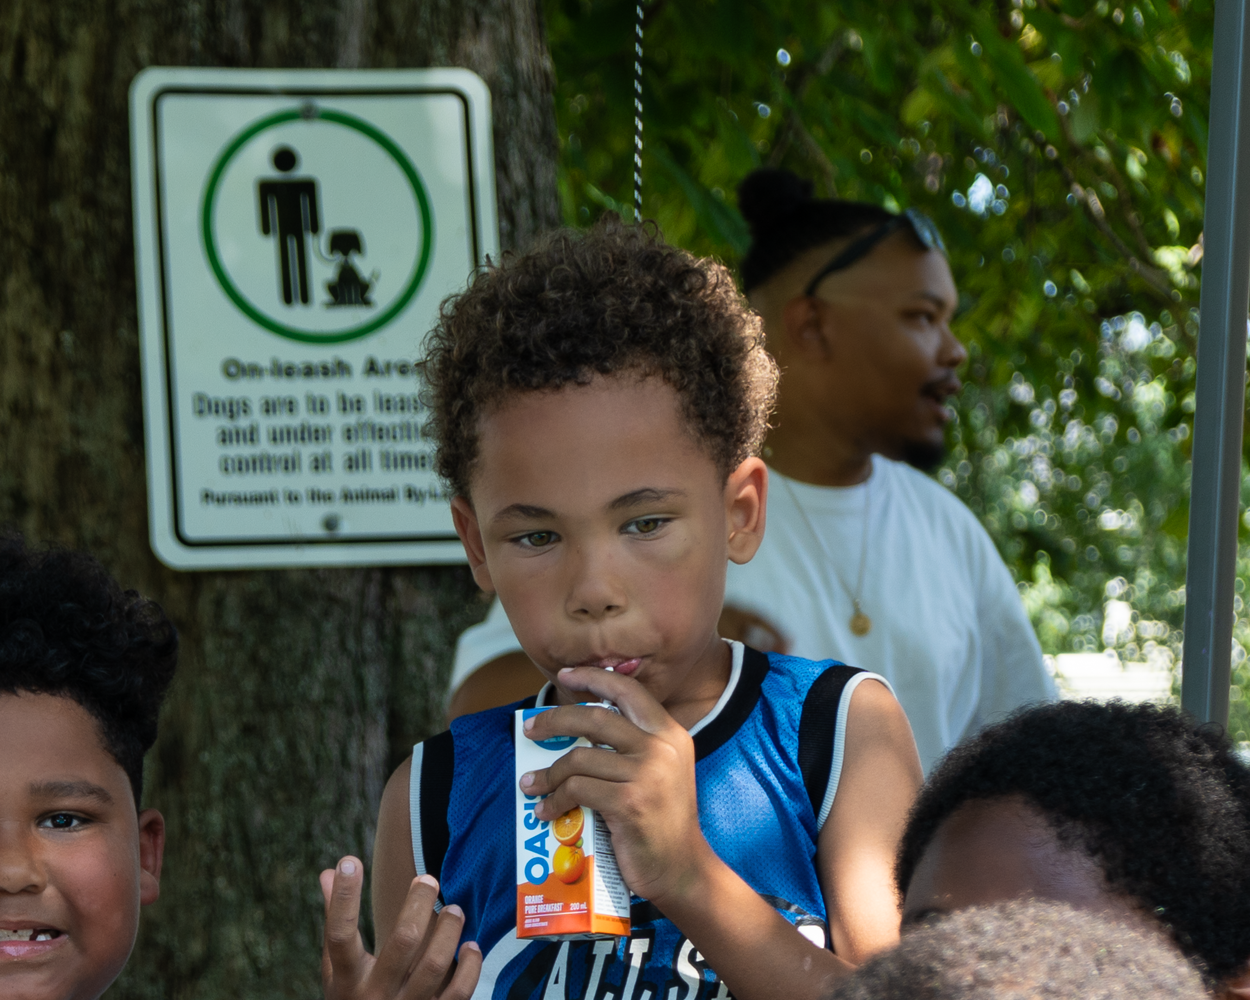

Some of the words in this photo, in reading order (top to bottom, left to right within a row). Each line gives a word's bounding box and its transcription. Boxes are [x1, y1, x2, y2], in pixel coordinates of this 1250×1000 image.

[220, 356, 352, 381] On-leash
[193, 391, 250, 419] Dogs
[260, 395, 297, 416] are
[305, 391, 330, 414] to
[337, 390, 366, 414] be
[374, 389, 426, 413] leas
[216, 422, 258, 445] and
[268, 422, 332, 444] under
[342, 420, 422, 444] effecti
[220, 451, 300, 474] control
[310, 451, 332, 472] at
[344, 449, 371, 472] all
[200, 487, 278, 506] Pursuant
[284, 487, 299, 504] to
[306, 487, 334, 504] the
[524, 895, 544, 904] ORANGE
[524, 905, 538, 915] PURE
[570, 902, 580, 911] 200
